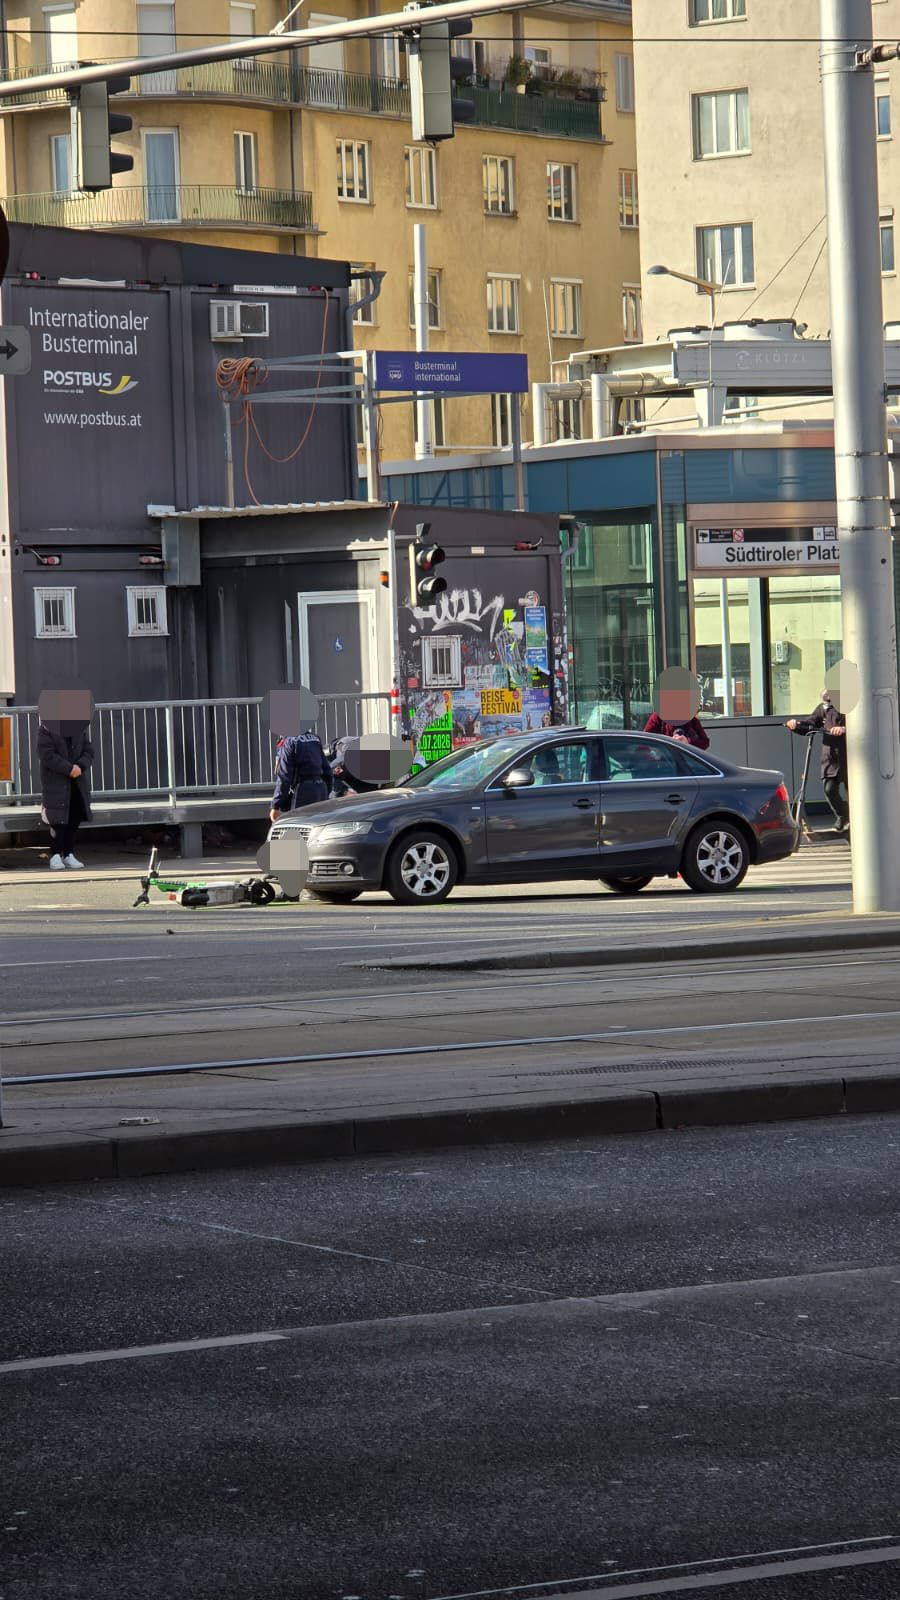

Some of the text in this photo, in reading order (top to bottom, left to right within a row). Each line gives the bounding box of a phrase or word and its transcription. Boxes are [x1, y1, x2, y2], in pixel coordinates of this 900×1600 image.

[29, 306, 149, 331] Internationaler
[42, 333, 138, 355] Busterminal
[414, 361, 457, 371] Busterminal
[43, 370, 112, 387] POSTBUS
[414, 372, 461, 382] International
[43, 411, 142, 428] www.postbus.at
[725, 546, 802, 562] Südtiroler
[480, 690, 505, 703] REISE
[481, 702, 522, 715] FESTIVAL
